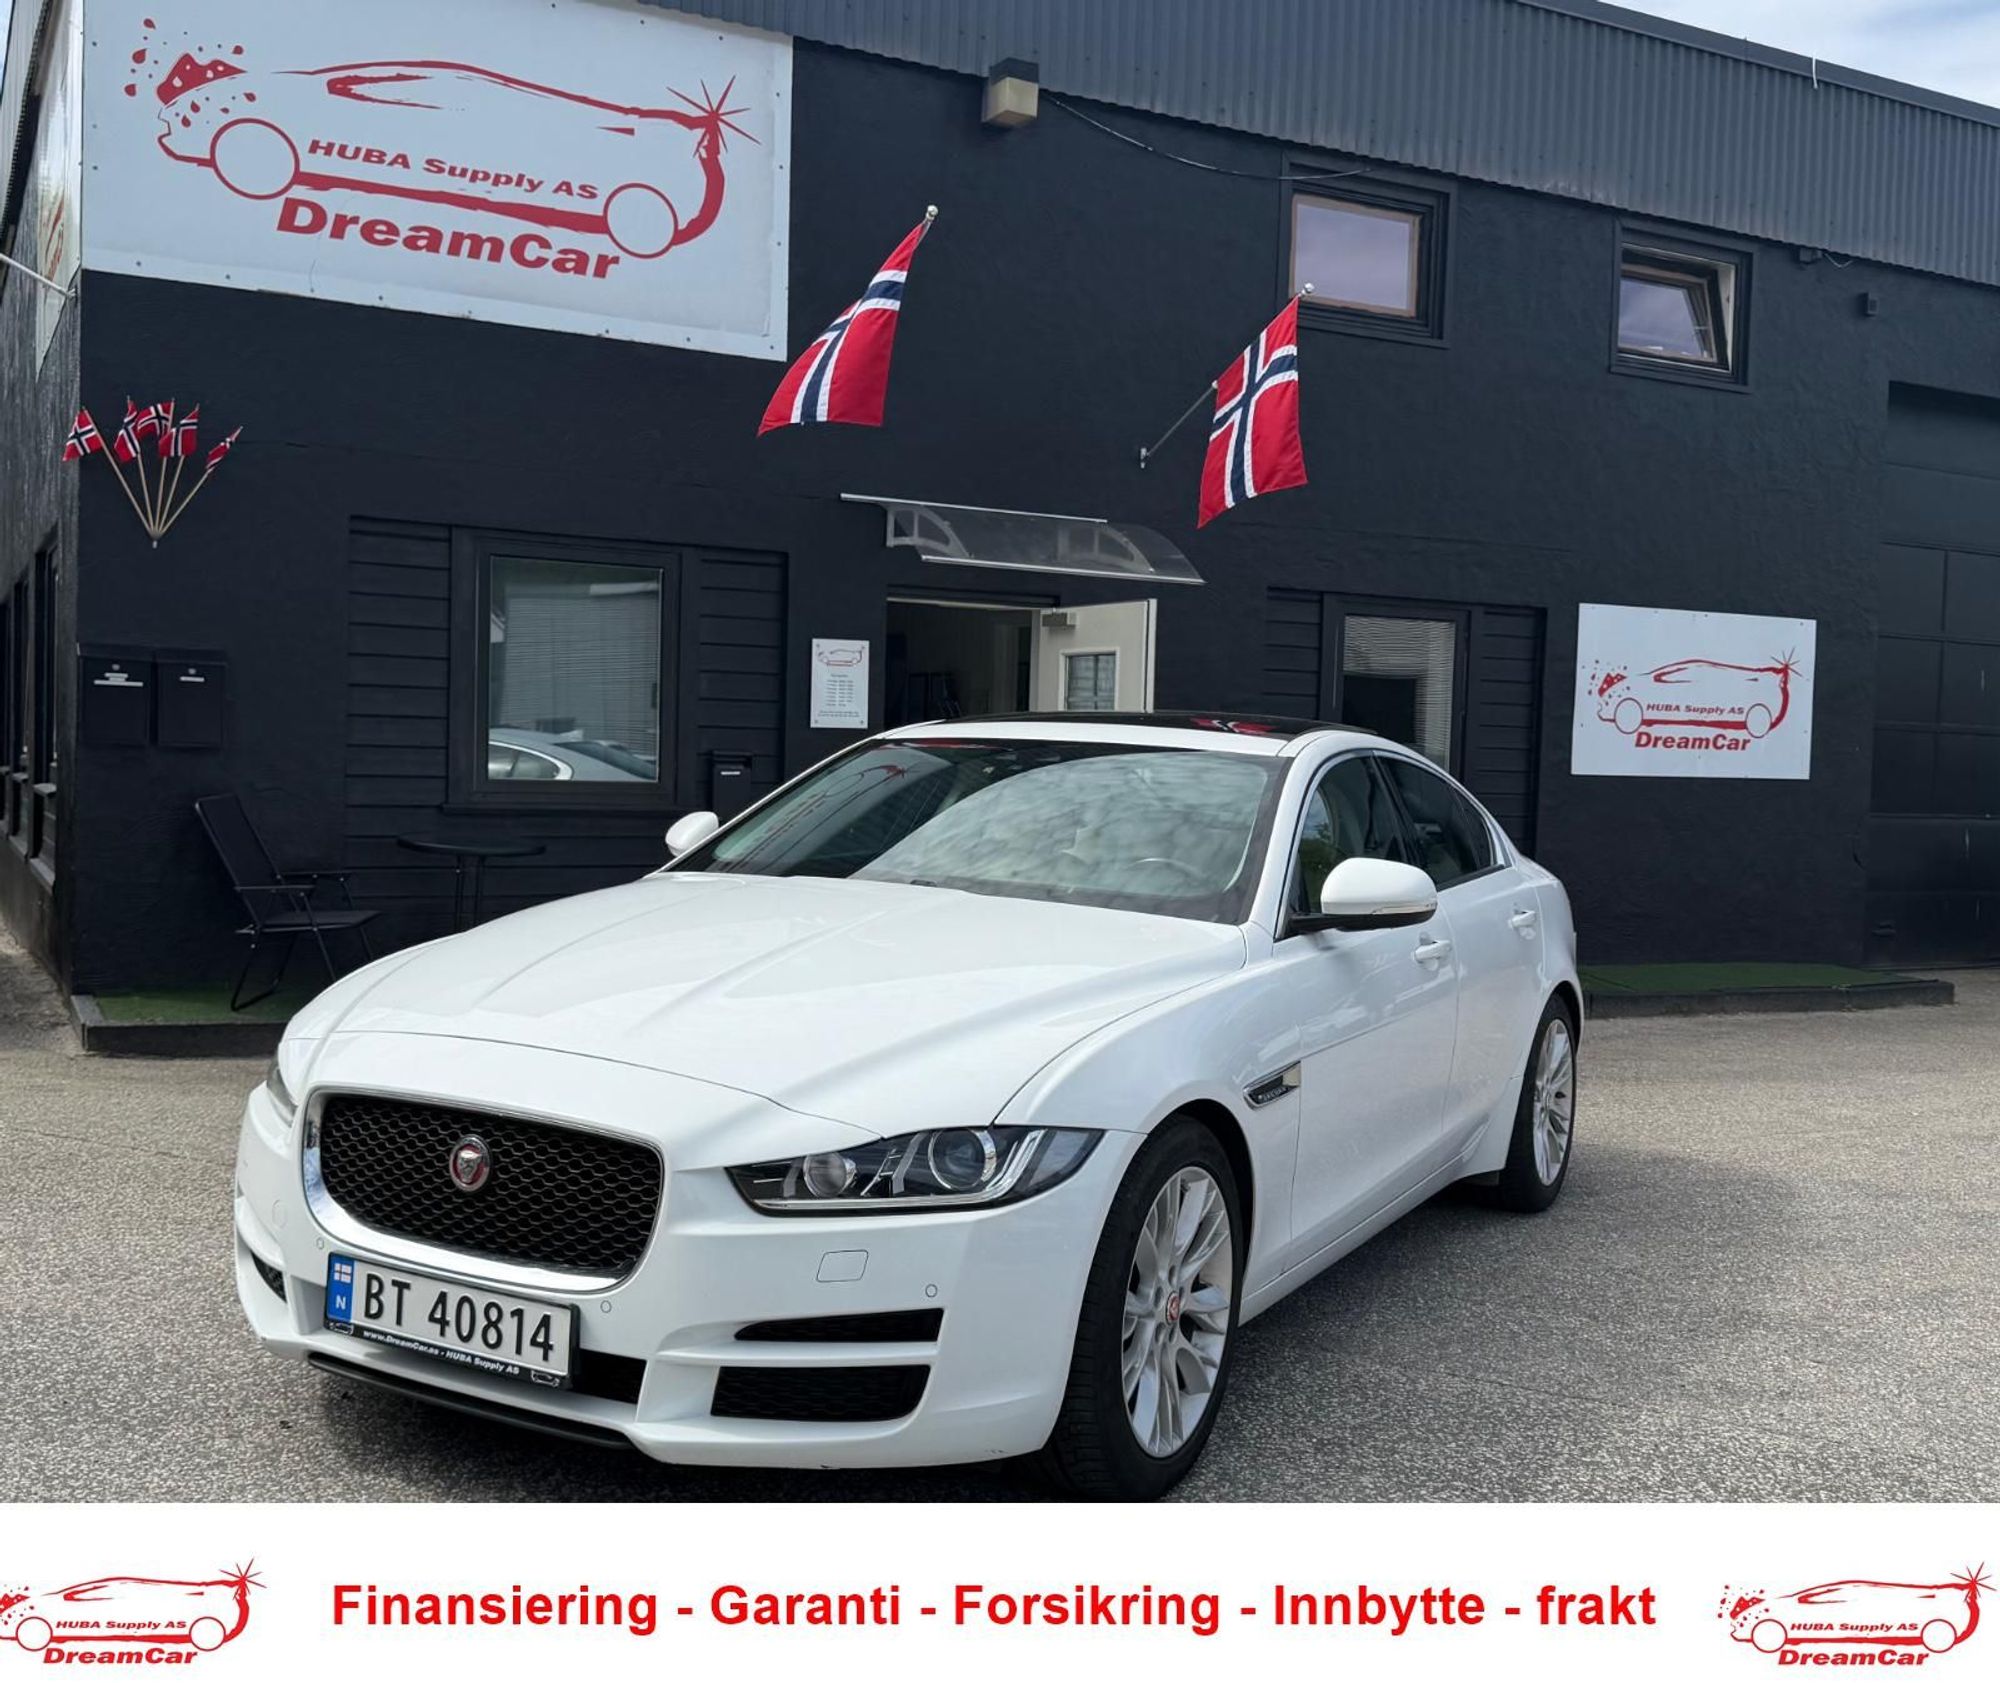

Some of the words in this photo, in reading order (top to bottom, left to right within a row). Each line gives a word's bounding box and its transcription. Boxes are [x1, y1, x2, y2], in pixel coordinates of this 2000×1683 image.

[308, 139, 412, 170] HUBA
[422, 158, 544, 193] Supply
[552, 180, 599, 200] AS
[276, 197, 620, 279] DreamCar
[1646, 703, 1681, 713] HUBA
[1684, 705, 1725, 716] Supply
[1728, 706, 1745, 716] AS
[1635, 731, 1751, 751] DreamCar
[335, 1295, 347, 1311] N
[363, 1272, 411, 1326] BT
[427, 1290, 554, 1362] 40814
[474, 1356, 505, 1372] Supply
